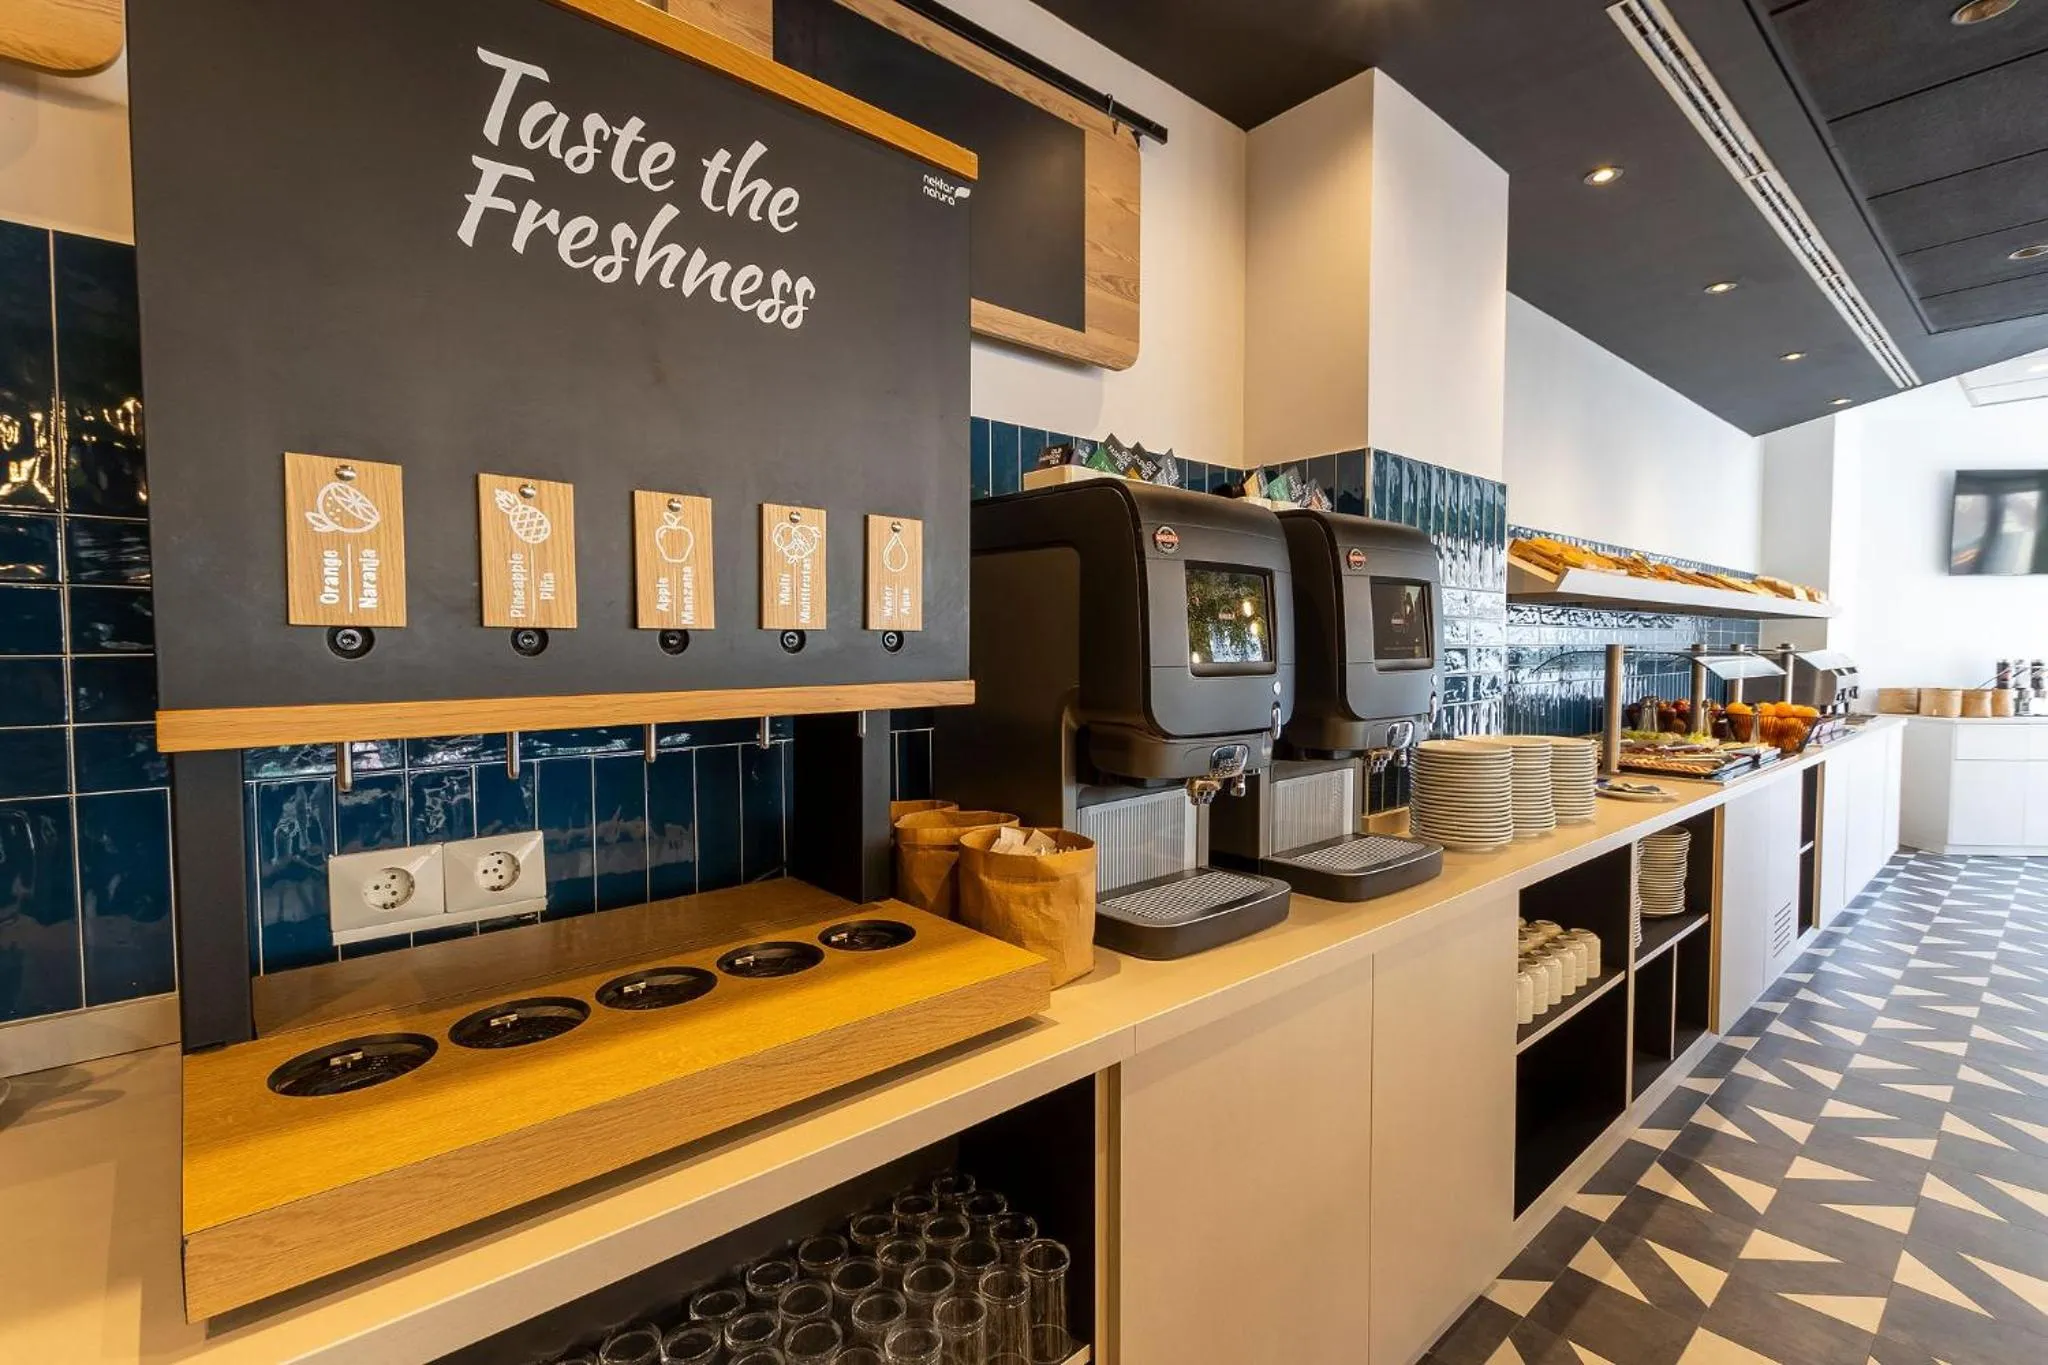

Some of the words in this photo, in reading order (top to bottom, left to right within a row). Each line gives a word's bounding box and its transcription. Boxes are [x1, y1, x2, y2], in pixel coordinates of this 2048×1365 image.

[477, 46, 676, 192] Taste
[701, 140, 800, 233] the
[923, 174, 955, 193] nektar
[923, 186, 955, 206] natura
[457, 155, 816, 330] Freshness
[320, 550, 341, 604] Orange
[359, 550, 379, 608] Naranja
[510, 553, 525, 618] Pineapple
[656, 577, 670, 612] Apple
[681, 567, 695, 624] Manzana
